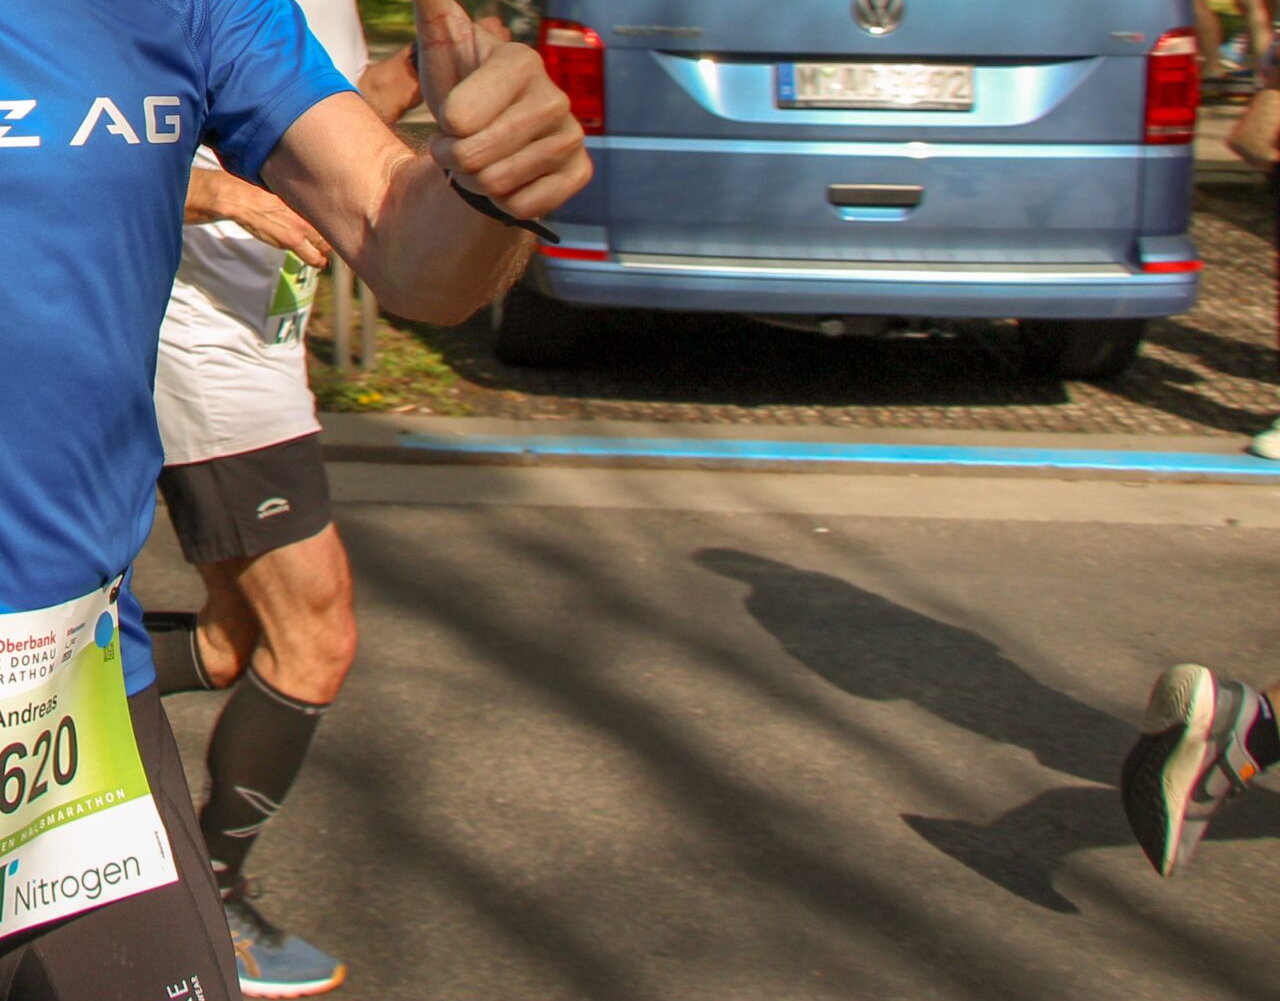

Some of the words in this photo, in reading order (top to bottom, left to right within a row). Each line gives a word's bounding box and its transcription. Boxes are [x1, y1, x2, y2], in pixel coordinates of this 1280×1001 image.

[69, 96, 181, 147] AG
[10, 648, 57, 669] DONAU
[20, 788, 126, 841] HALBMARATHON
[14, 855, 141, 917] Nitrogen
